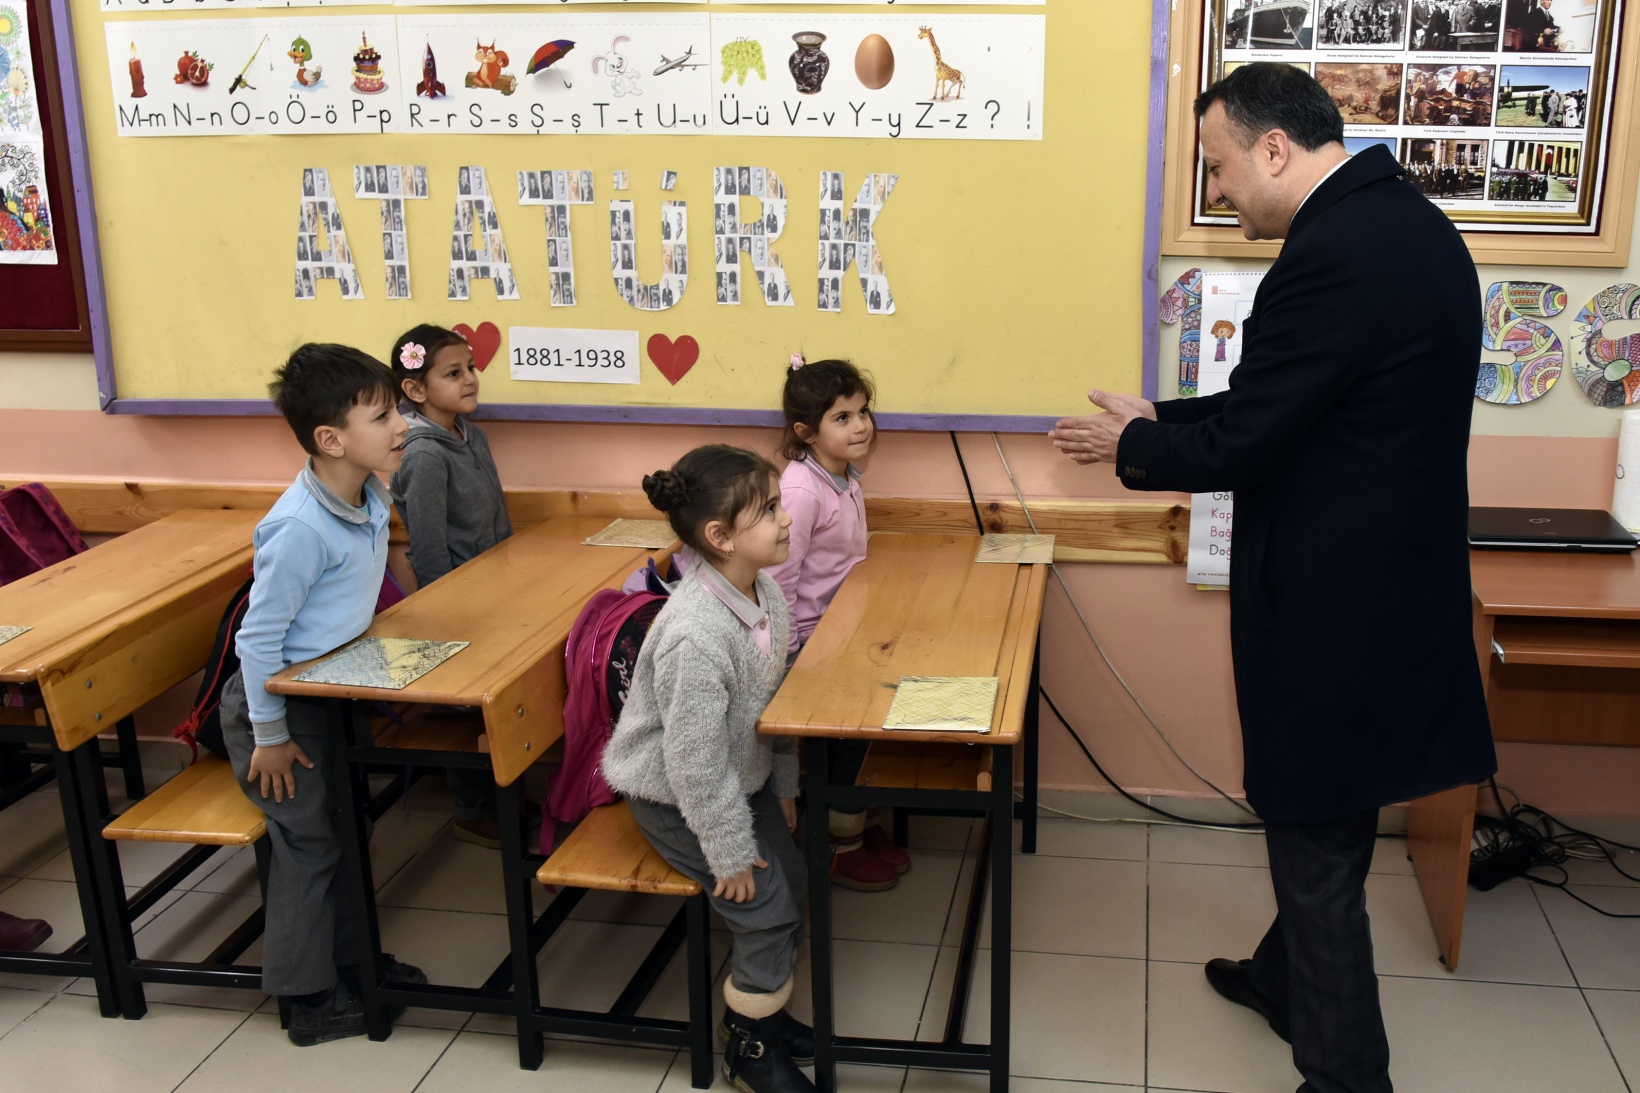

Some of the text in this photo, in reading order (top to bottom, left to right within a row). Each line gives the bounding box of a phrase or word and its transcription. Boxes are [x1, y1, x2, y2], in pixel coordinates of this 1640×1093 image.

[173, 103, 222, 126] N-n
[231, 101, 279, 126] O-o
[286, 95, 338, 125] Ö-ö
[353, 99, 392, 134] P-p
[720, 94, 769, 126] Ü-ü
[984, 99, 1001, 129] ?
[294, 164, 899, 314] ATATÜRK
[513, 347, 626, 369] 1881-1938
